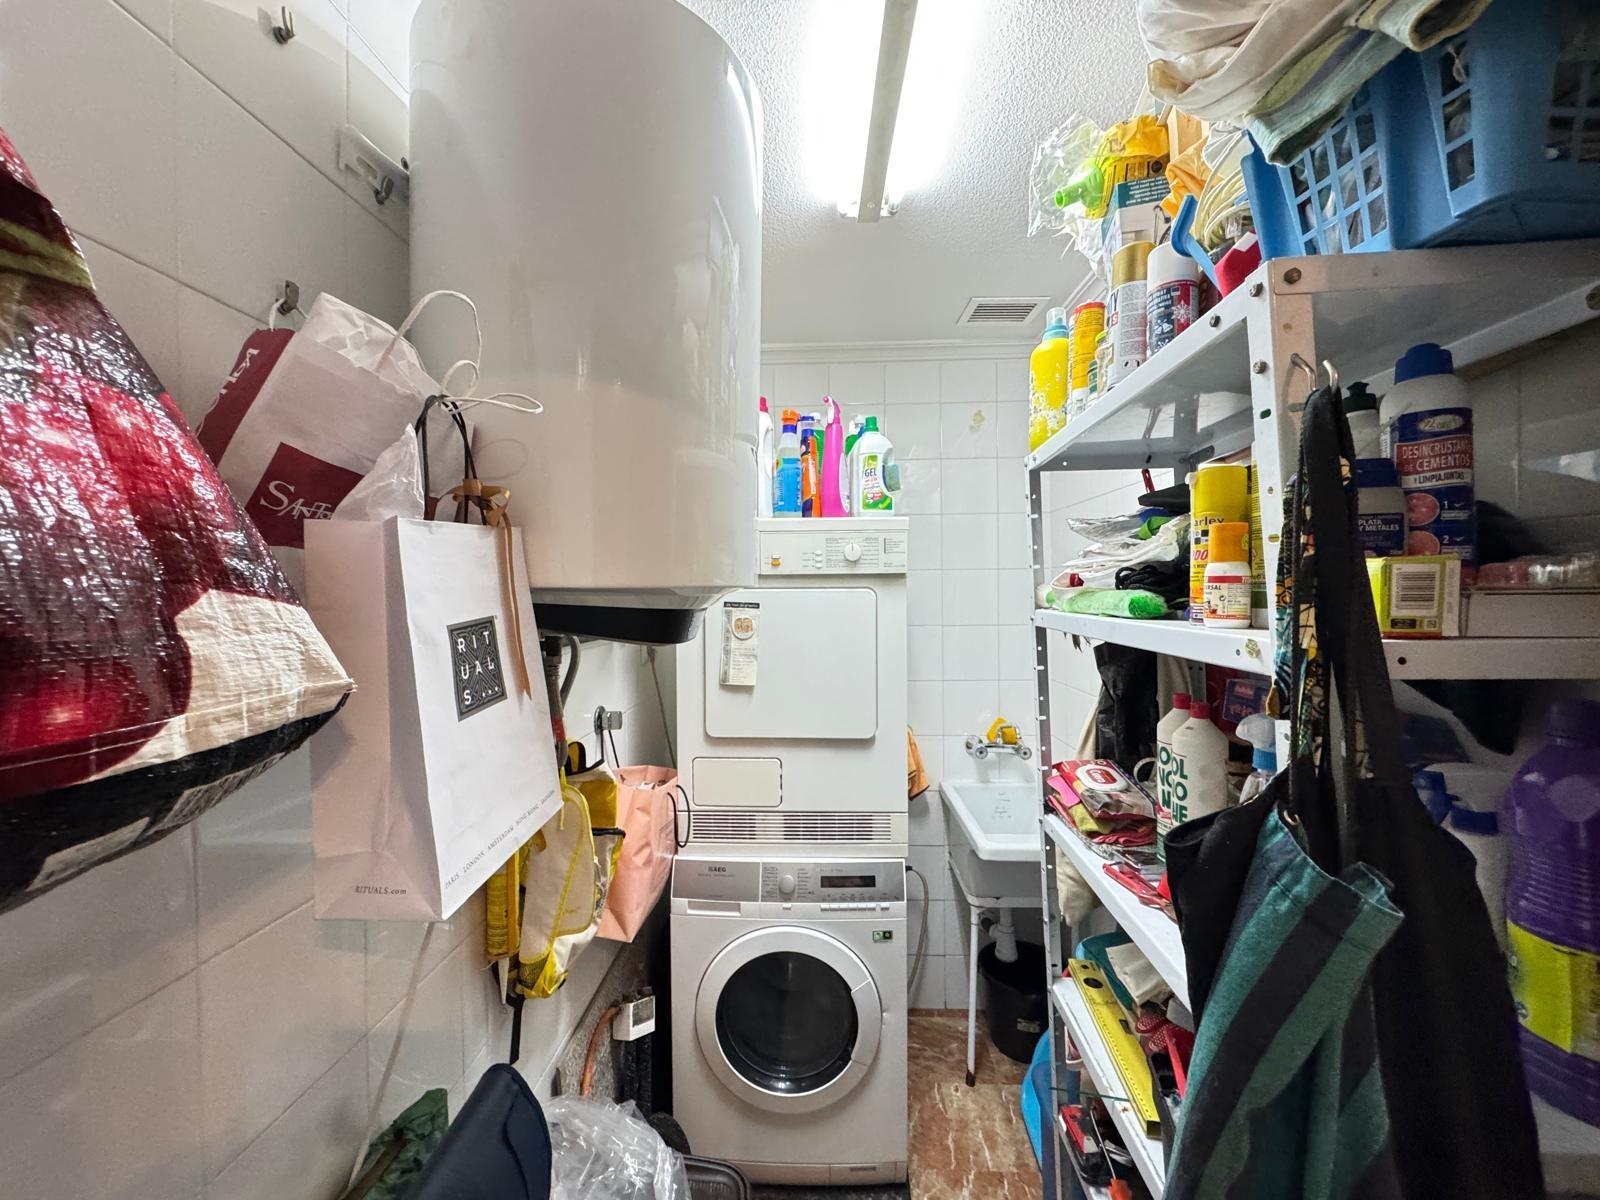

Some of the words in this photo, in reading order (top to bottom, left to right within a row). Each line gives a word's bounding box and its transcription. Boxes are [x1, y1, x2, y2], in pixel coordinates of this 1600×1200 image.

[1416, 454, 1470, 471] CEMENTOS
[864, 467, 877, 477] GEL
[1443, 500, 1449, 509] 1
[1365, 524, 1400, 532] METALES
[354, 885, 407, 895] RITUALS.com
